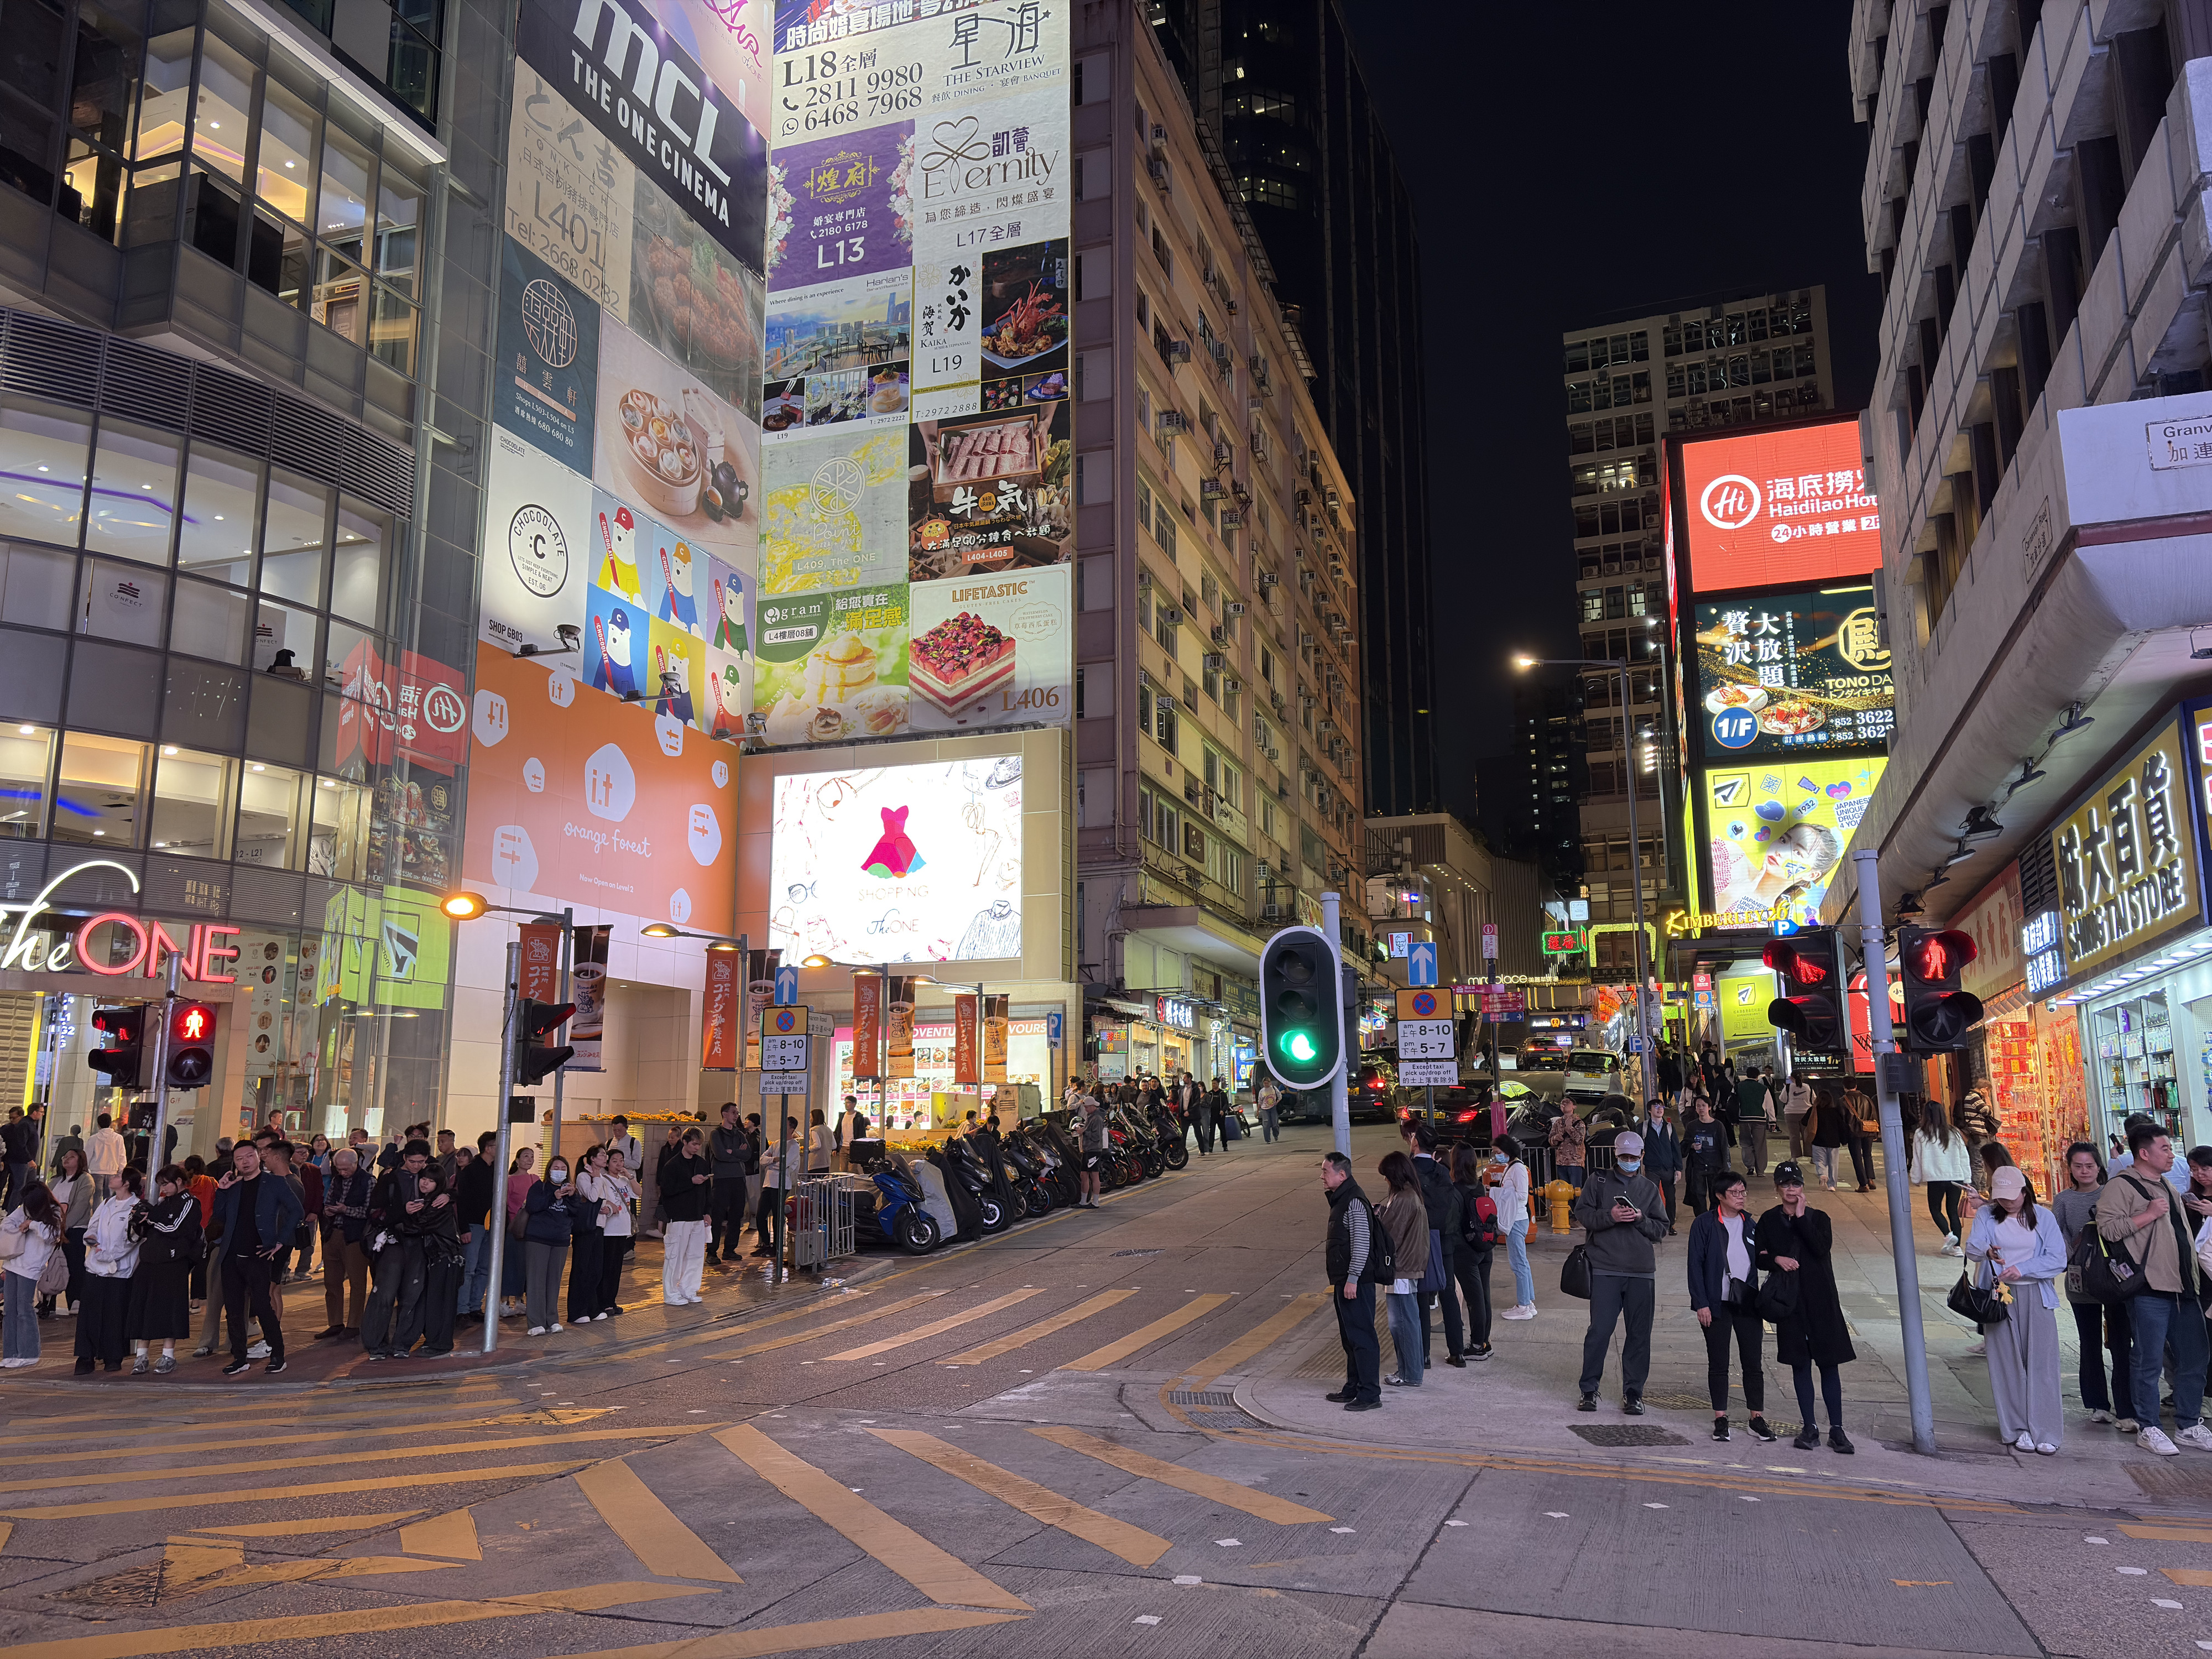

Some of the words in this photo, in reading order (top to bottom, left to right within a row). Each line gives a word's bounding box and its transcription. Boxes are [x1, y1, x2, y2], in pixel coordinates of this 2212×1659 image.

[786, 4, 914, 51] 時尚婚宴場地
[943, 72, 972, 87] THE
[975, 54, 1046, 81] STARVIEW
[805, 76, 858, 108] 2811
[867, 62, 924, 93] 9980
[954, 85, 985, 98] DINING
[1024, 68, 1062, 82] BANQUET
[804, 101, 859, 131] 6468
[868, 86, 923, 118] 7968
[571, 49, 612, 113] THE
[617, 97, 656, 157] ONE
[661, 139, 729, 228] CINEMA
[534, 180, 605, 272] L401
[812, 206, 866, 228] 婚宴專門店
[818, 225, 842, 238] 2180
[844, 220, 868, 233] 6178
[507, 207, 536, 247] Tel:
[540, 234, 579, 280] 2668
[582, 268, 620, 312] 0282
[817, 236, 865, 269] L13
[867, 274, 909, 288] Harlan's
[787, 295, 803, 303] dining
[817, 288, 844, 297] experience
[946, 265, 971, 331] かいか
[920, 338, 947, 348] KAIKA
[932, 354, 963, 374] L19
[515, 392, 531, 407] Shops
[532, 404, 559, 425] L503-L504
[568, 424, 575, 434] L5
[952, 403, 977, 413] 2888
[538, 420, 550, 433] 680
[552, 429, 564, 441] 680
[565, 438, 573, 447] 80
[1714, 486, 1749, 519] Hi
[1770, 498, 1844, 518] Haidilao
[514, 509, 565, 557] CHOCOOLATE
[813, 519, 861, 541] Point
[798, 560, 826, 571] L409,
[853, 553, 876, 563] ONE
[967, 550, 1008, 562] L404-L405
[522, 564, 538, 575] SIMPLE
[542, 572, 552, 583] NEAT
[109, 592, 143, 607] CONFECT
[952, 581, 1027, 603] LIFETASTIC
[781, 604, 821, 620] gram
[959, 601, 999, 609] GLUTEN-FREE
[489, 619, 506, 635] SHOP
[507, 627, 523, 643] GB03
[1754, 612, 1786, 688] 大放題
[1825, 676, 1870, 690] TONO
[1001, 686, 1059, 711] L406
[1856, 709, 1893, 724] 3622
[1718, 718, 1752, 739] 1/F
[1734, 781, 1746, 800] matsukiyo
[1797, 800, 1815, 815] 1932
[564, 821, 609, 854] orange
[612, 828, 651, 858] forest
[579, 873, 592, 884] Now
[593, 877, 608, 888] Open
[616, 883, 629, 892] Level
[2128, 858, 2186, 930] STORE
[890, 919, 919, 933] ONE
[1666, 908, 1764, 935] KIMBERLEY
[1767, 900, 1788, 921] 26
[75, 913, 241, 983] ONE
[1548, 935, 1576, 950] 蓮香
[1049, 1016, 1058, 1029] P
[1226, 1017, 1230, 1028] P
[1420, 1025, 1451, 1035] 8-10
[1100, 1031, 1127, 1041] 環球生果
